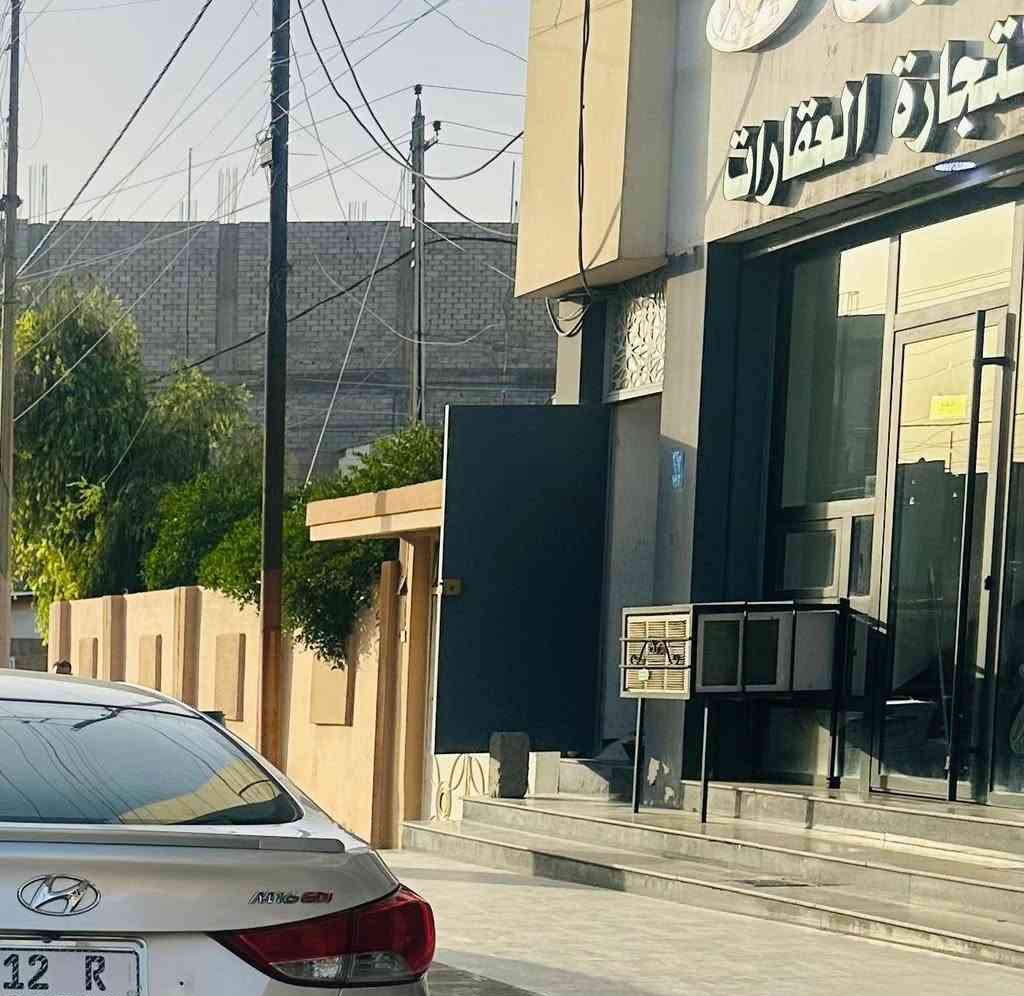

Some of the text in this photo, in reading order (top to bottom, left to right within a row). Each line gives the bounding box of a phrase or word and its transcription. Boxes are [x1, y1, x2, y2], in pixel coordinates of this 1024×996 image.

[723, 14, 1024, 206] تجارة العقارات
[2, 953, 107, 991] 12 R
